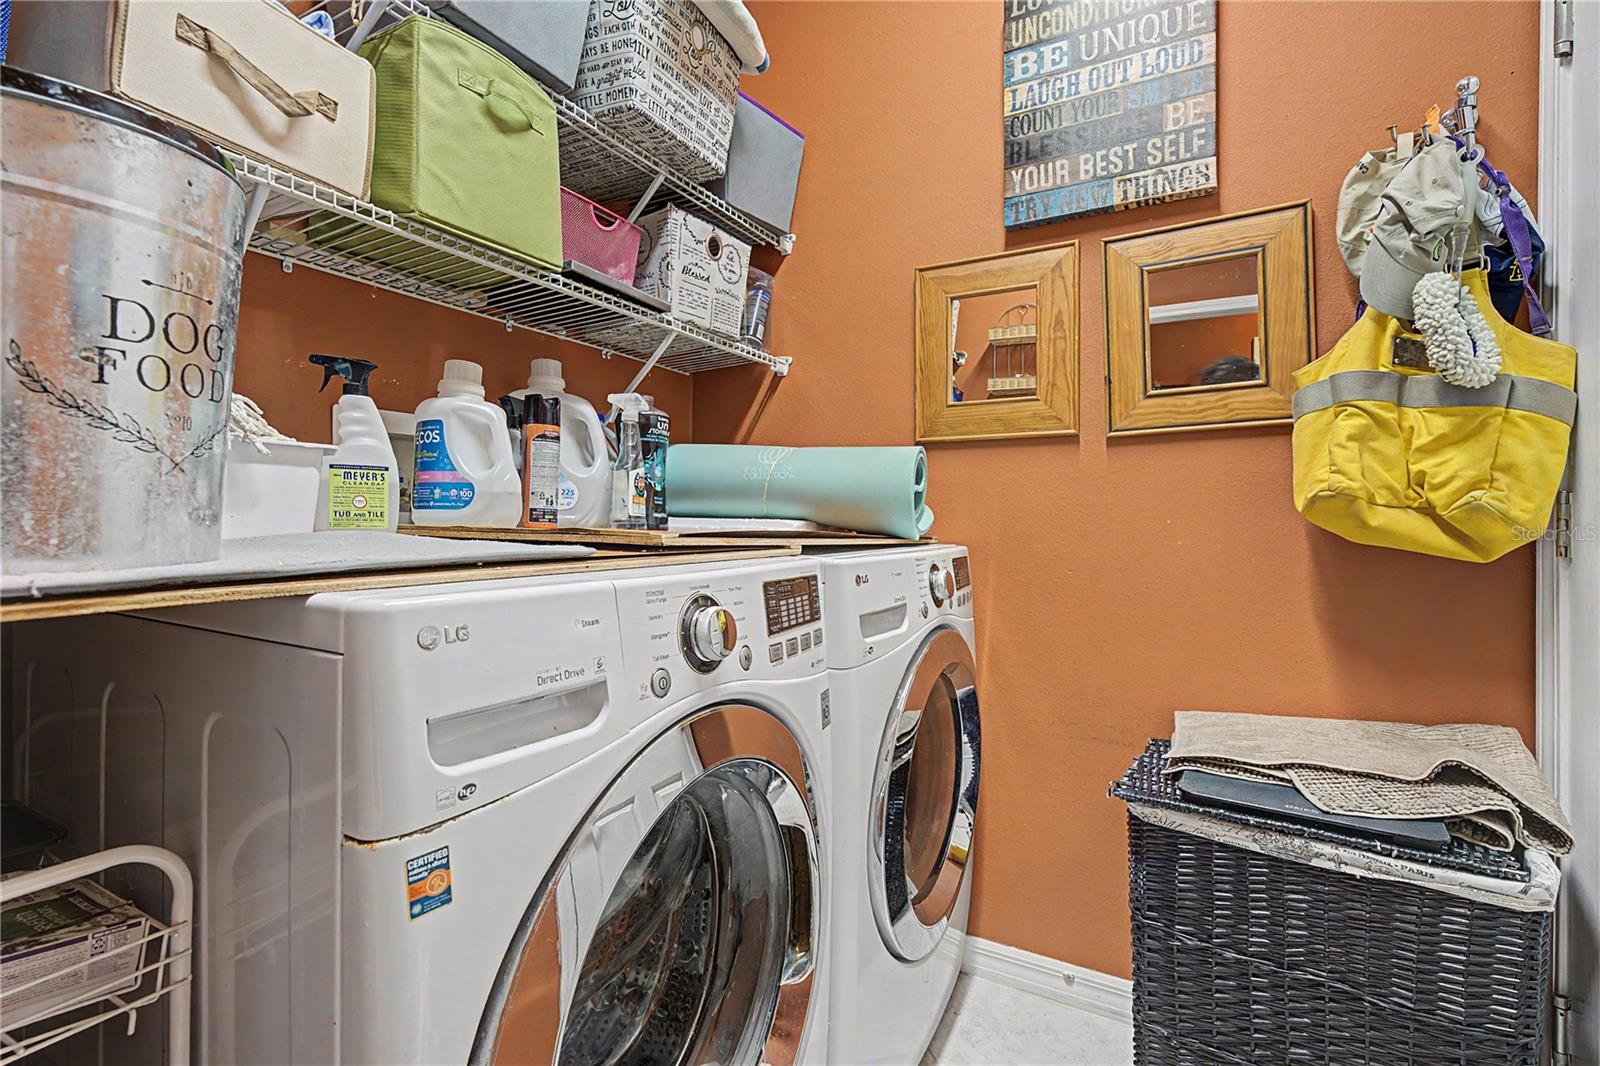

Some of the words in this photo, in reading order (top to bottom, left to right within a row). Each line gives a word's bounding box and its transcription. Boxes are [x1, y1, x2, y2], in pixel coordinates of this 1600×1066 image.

[600, 42, 609, 54] BE
[1010, 40, 1070, 82] BE
[1078, 3, 1206, 61] UNIQUE
[1010, 72, 1081, 112] LAUGH
[1087, 58, 1133, 91] OUT
[1140, 38, 1204, 79] LOUD
[1010, 107, 1067, 138] COUNT
[1070, 91, 1122, 121] YOUR
[1167, 98, 1206, 132] BE
[1011, 159, 1070, 194] YOUR
[1079, 143, 1138, 180] BEST
[1147, 128, 1206, 166] SELF
[1010, 198, 1052, 223] TRY
[1060, 182, 1112, 214] NEW
[1117, 162, 1211, 201] THINGS
[101, 294, 224, 363] DOG
[91, 345, 225, 403] FOOD
[343, 471, 385, 481] MEYER'S
[561, 488, 575, 496] 225
[862, 575, 869, 584] LG
[443, 624, 470, 644] LG
[537, 673, 562, 686] Direct
[564, 668, 585, 680] Drive
[407, 848, 449, 871] CERTIFIED
[1400, 864, 1436, 880] PARIS
